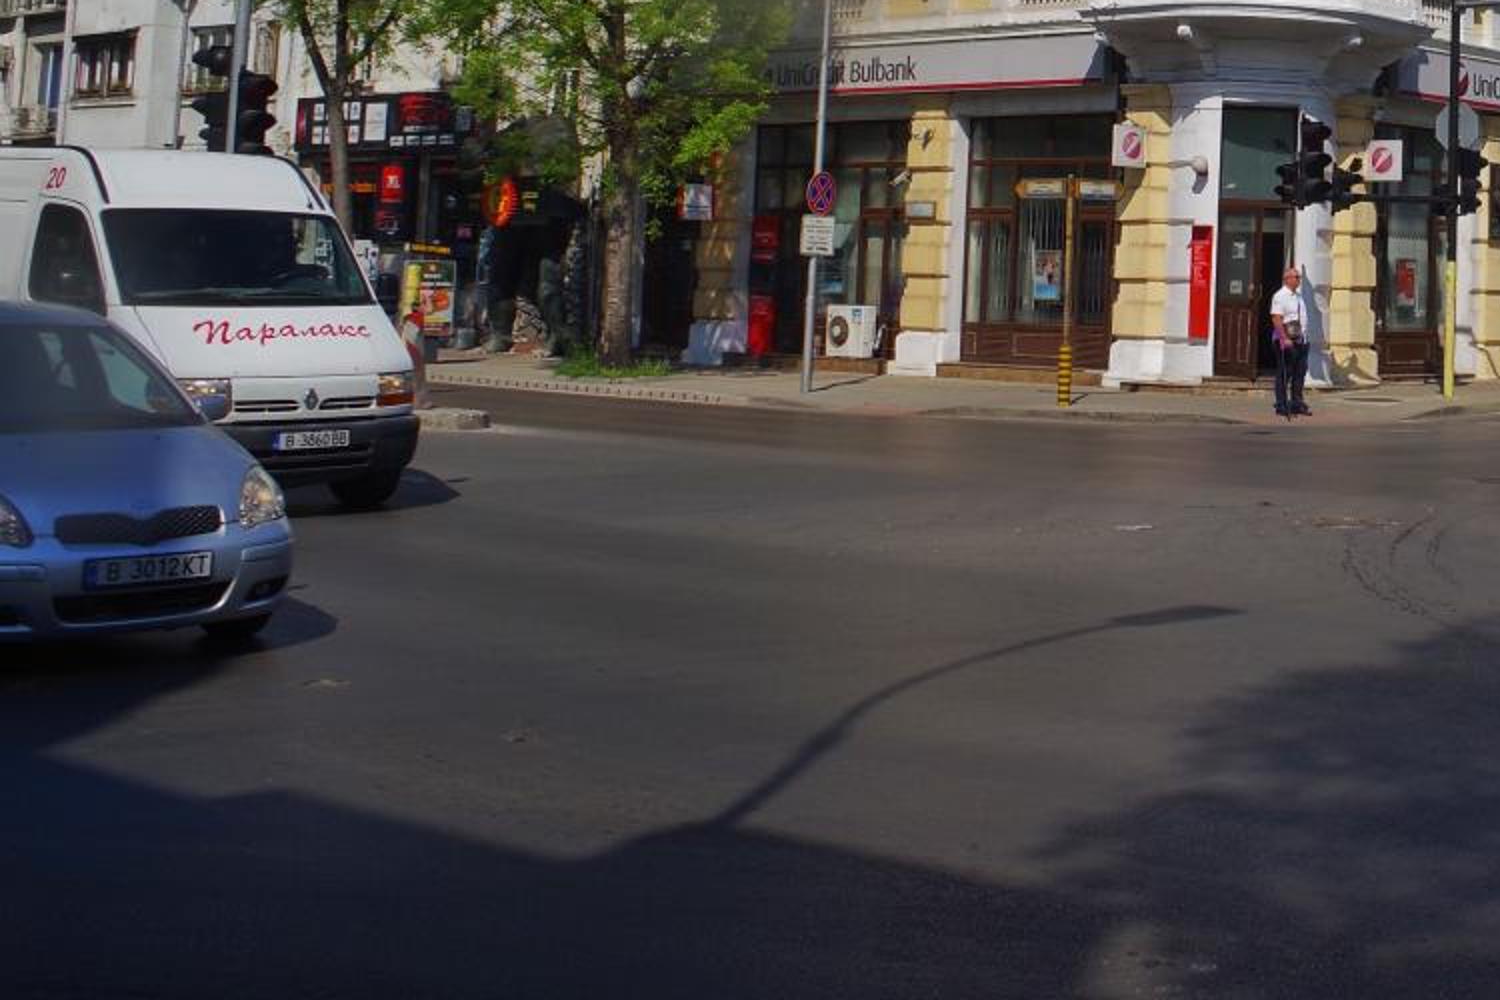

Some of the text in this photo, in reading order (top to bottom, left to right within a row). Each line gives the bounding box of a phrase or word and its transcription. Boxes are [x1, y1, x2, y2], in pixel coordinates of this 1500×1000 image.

[850, 56, 917, 83] Bulbank
[46, 167, 67, 189] 20
[193, 320, 371, 345] Паралакс
